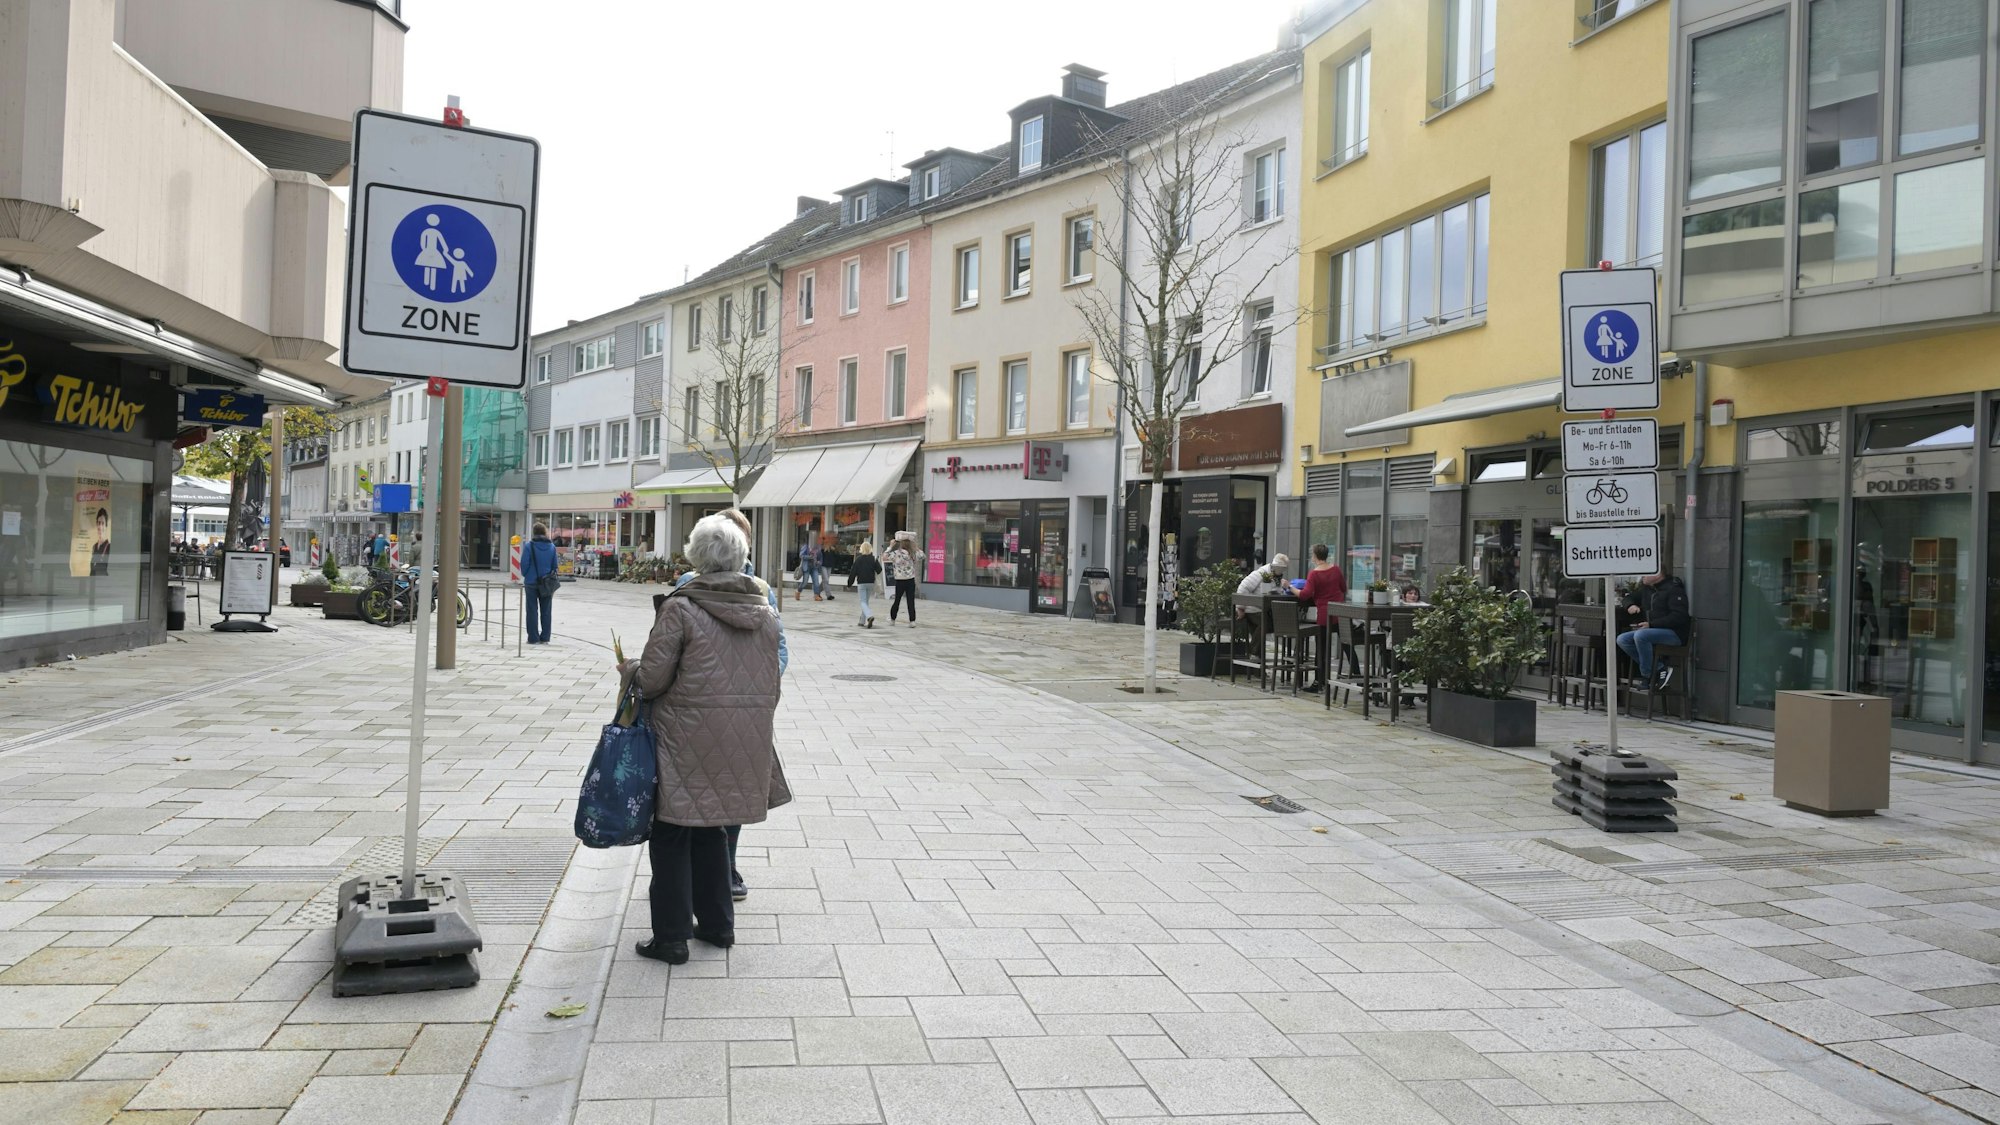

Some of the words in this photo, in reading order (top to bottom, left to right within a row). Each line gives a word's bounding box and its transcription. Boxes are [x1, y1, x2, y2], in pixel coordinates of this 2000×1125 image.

[402, 305, 480, 336] ZONE
[1592, 366, 1634, 381] ZONE
[50, 374, 145, 433] Tchibo
[200, 407, 249, 421] Tchibo
[1571, 426, 1586, 436] Be-
[1588, 425, 1603, 435] und
[1605, 424, 1642, 435] Entladen
[1583, 441, 1608, 451] Mo-Fr
[1610, 440, 1632, 450] 6-11h
[1589, 456, 1599, 466] Sa
[1601, 455, 1625, 466] 6-10h
[1866, 477, 1940, 493] POLDERS
[1945, 477, 1955, 490] 5
[1576, 510, 1588, 519] bis
[1589, 508, 1625, 518] Baustelle
[1627, 507, 1641, 516] frei
[1571, 545, 1652, 561] Schritttempo
